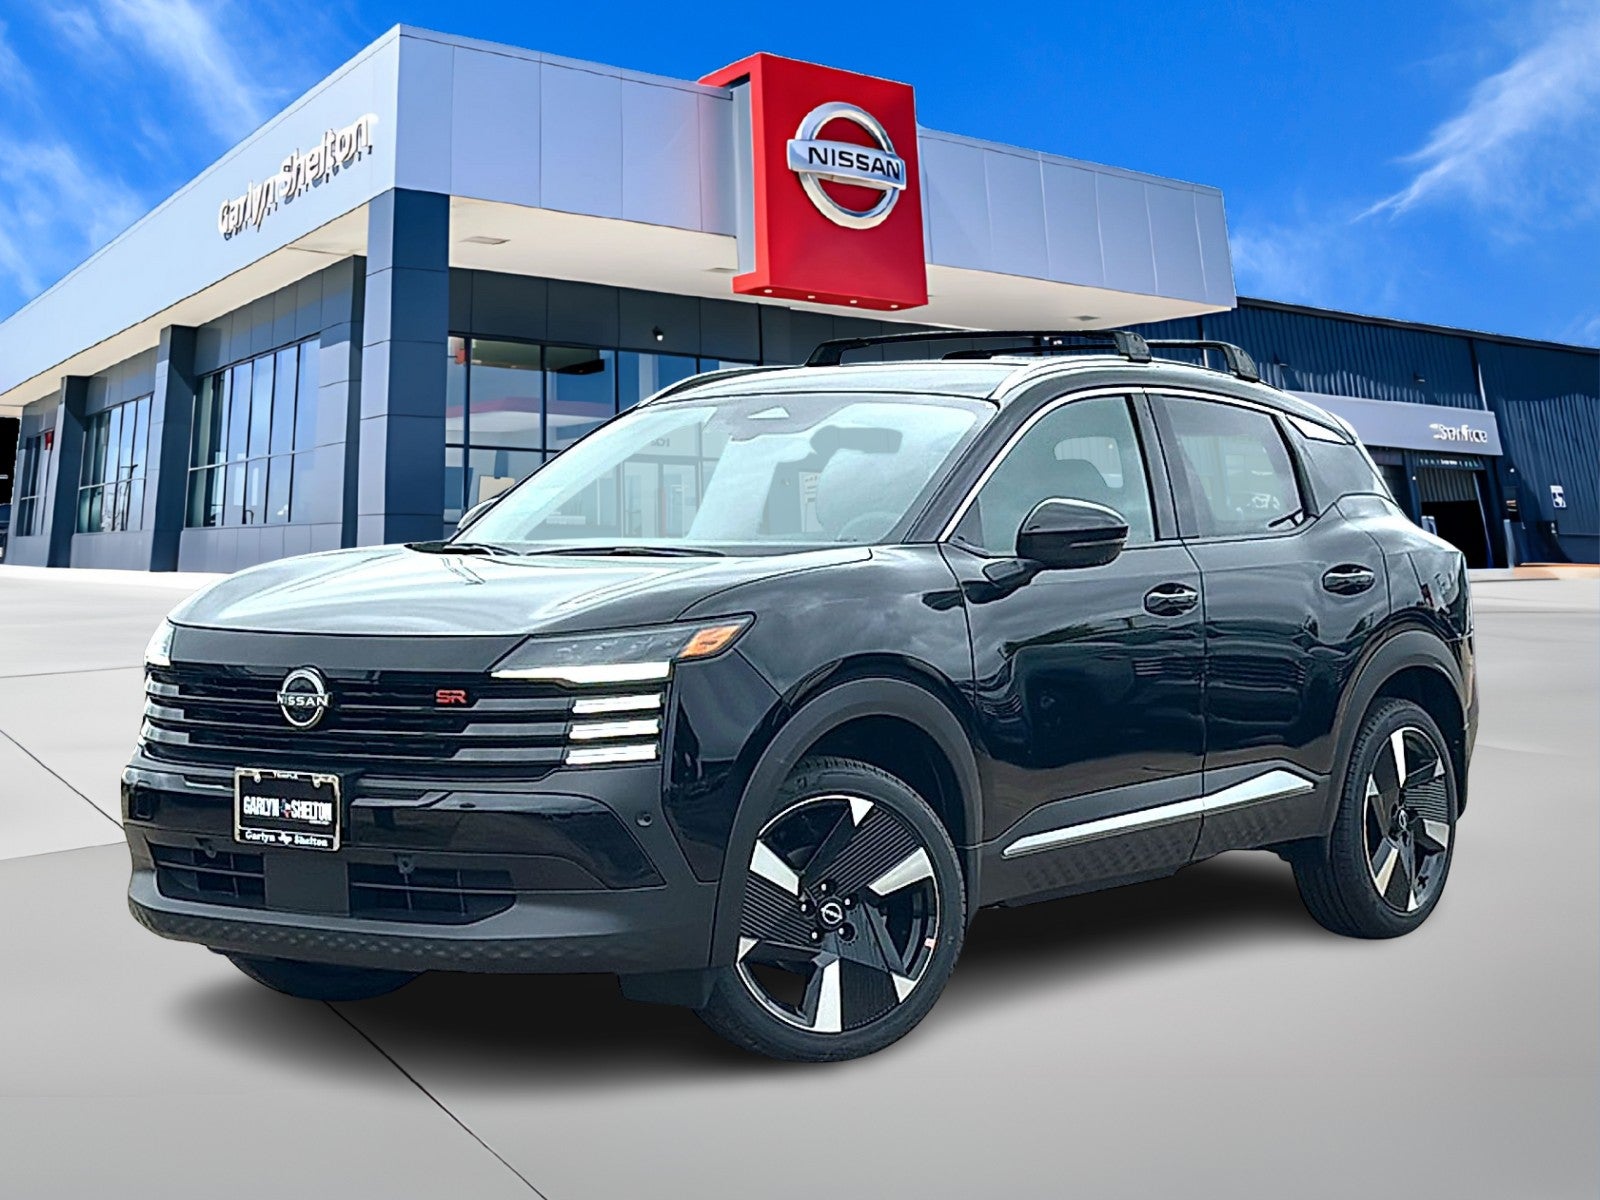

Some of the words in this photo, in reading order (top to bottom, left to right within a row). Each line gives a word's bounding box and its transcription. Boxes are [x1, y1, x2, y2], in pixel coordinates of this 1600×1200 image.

[279, 116, 371, 198] Shelton
[808, 147, 900, 180] NISSAN
[277, 692, 329, 707] NISSAN
[436, 689, 467, 703] SR
[243, 795, 280, 817] GARLYN
[291, 799, 332, 822] SHELTON
